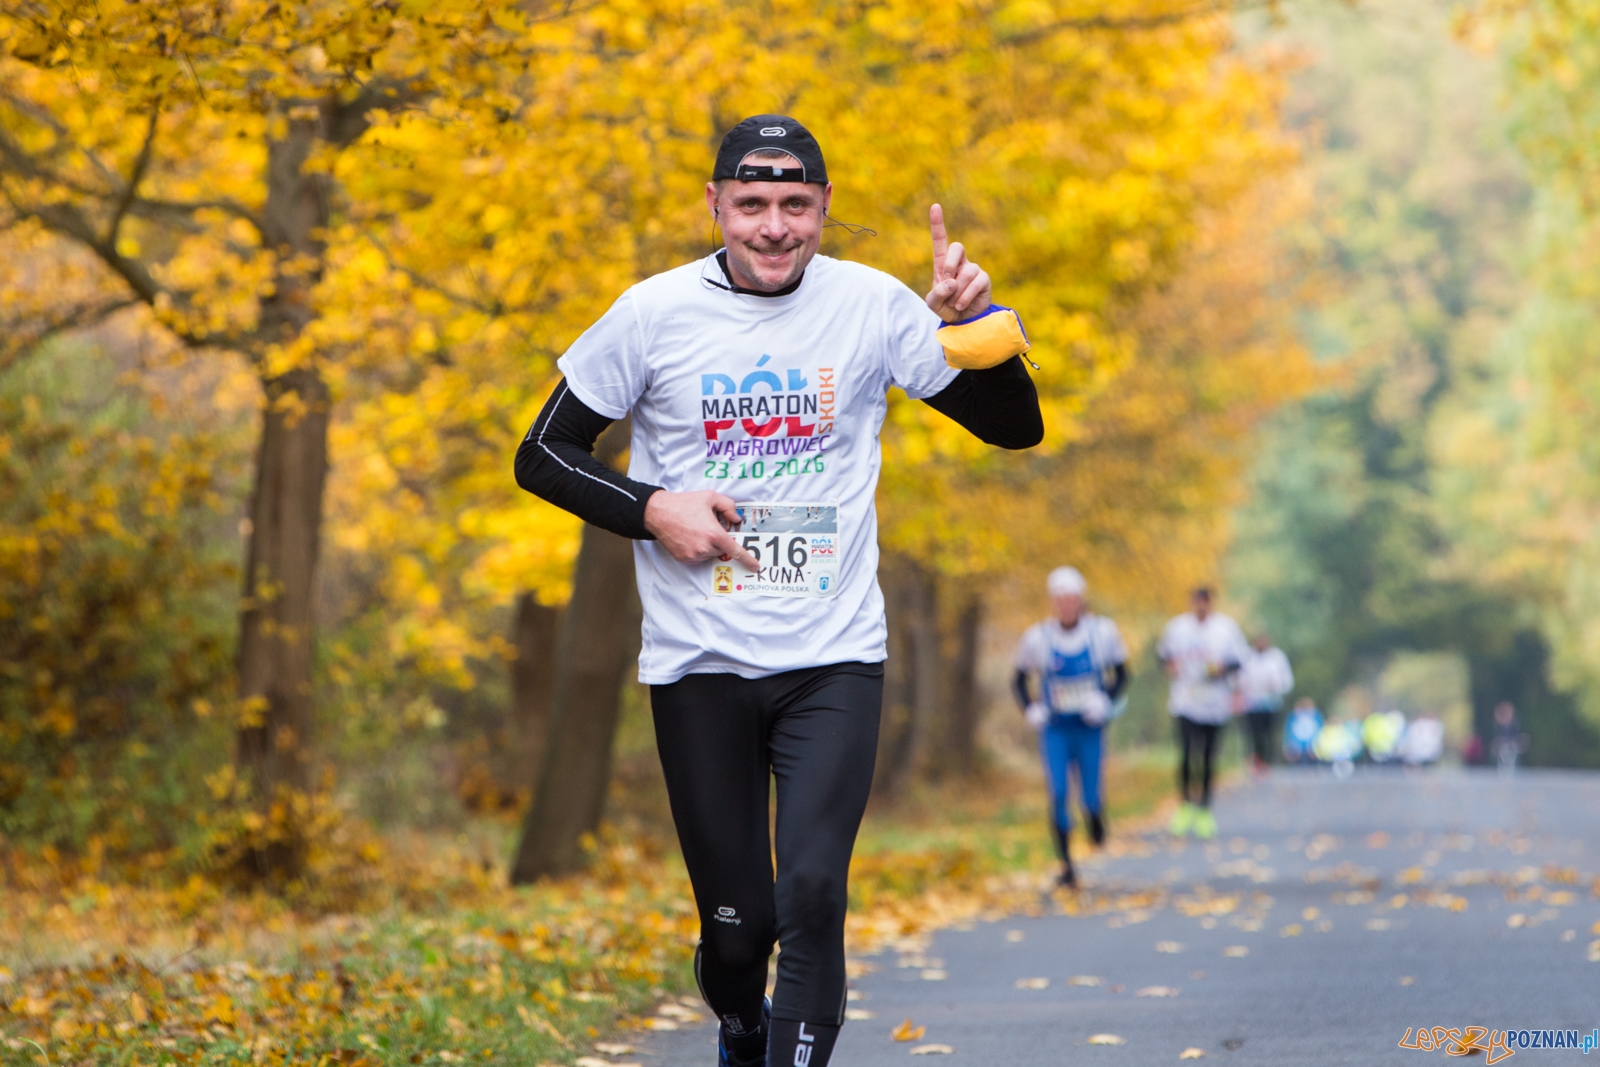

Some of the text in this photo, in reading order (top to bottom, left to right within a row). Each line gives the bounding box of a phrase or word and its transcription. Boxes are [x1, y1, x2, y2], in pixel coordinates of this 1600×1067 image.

[701, 394, 817, 420] MARATON
[818, 367, 835, 434] SKOKI
[706, 434, 831, 461] WĄGROWIEC
[704, 454, 825, 480] 23.10.2016
[742, 535, 808, 568] 516
